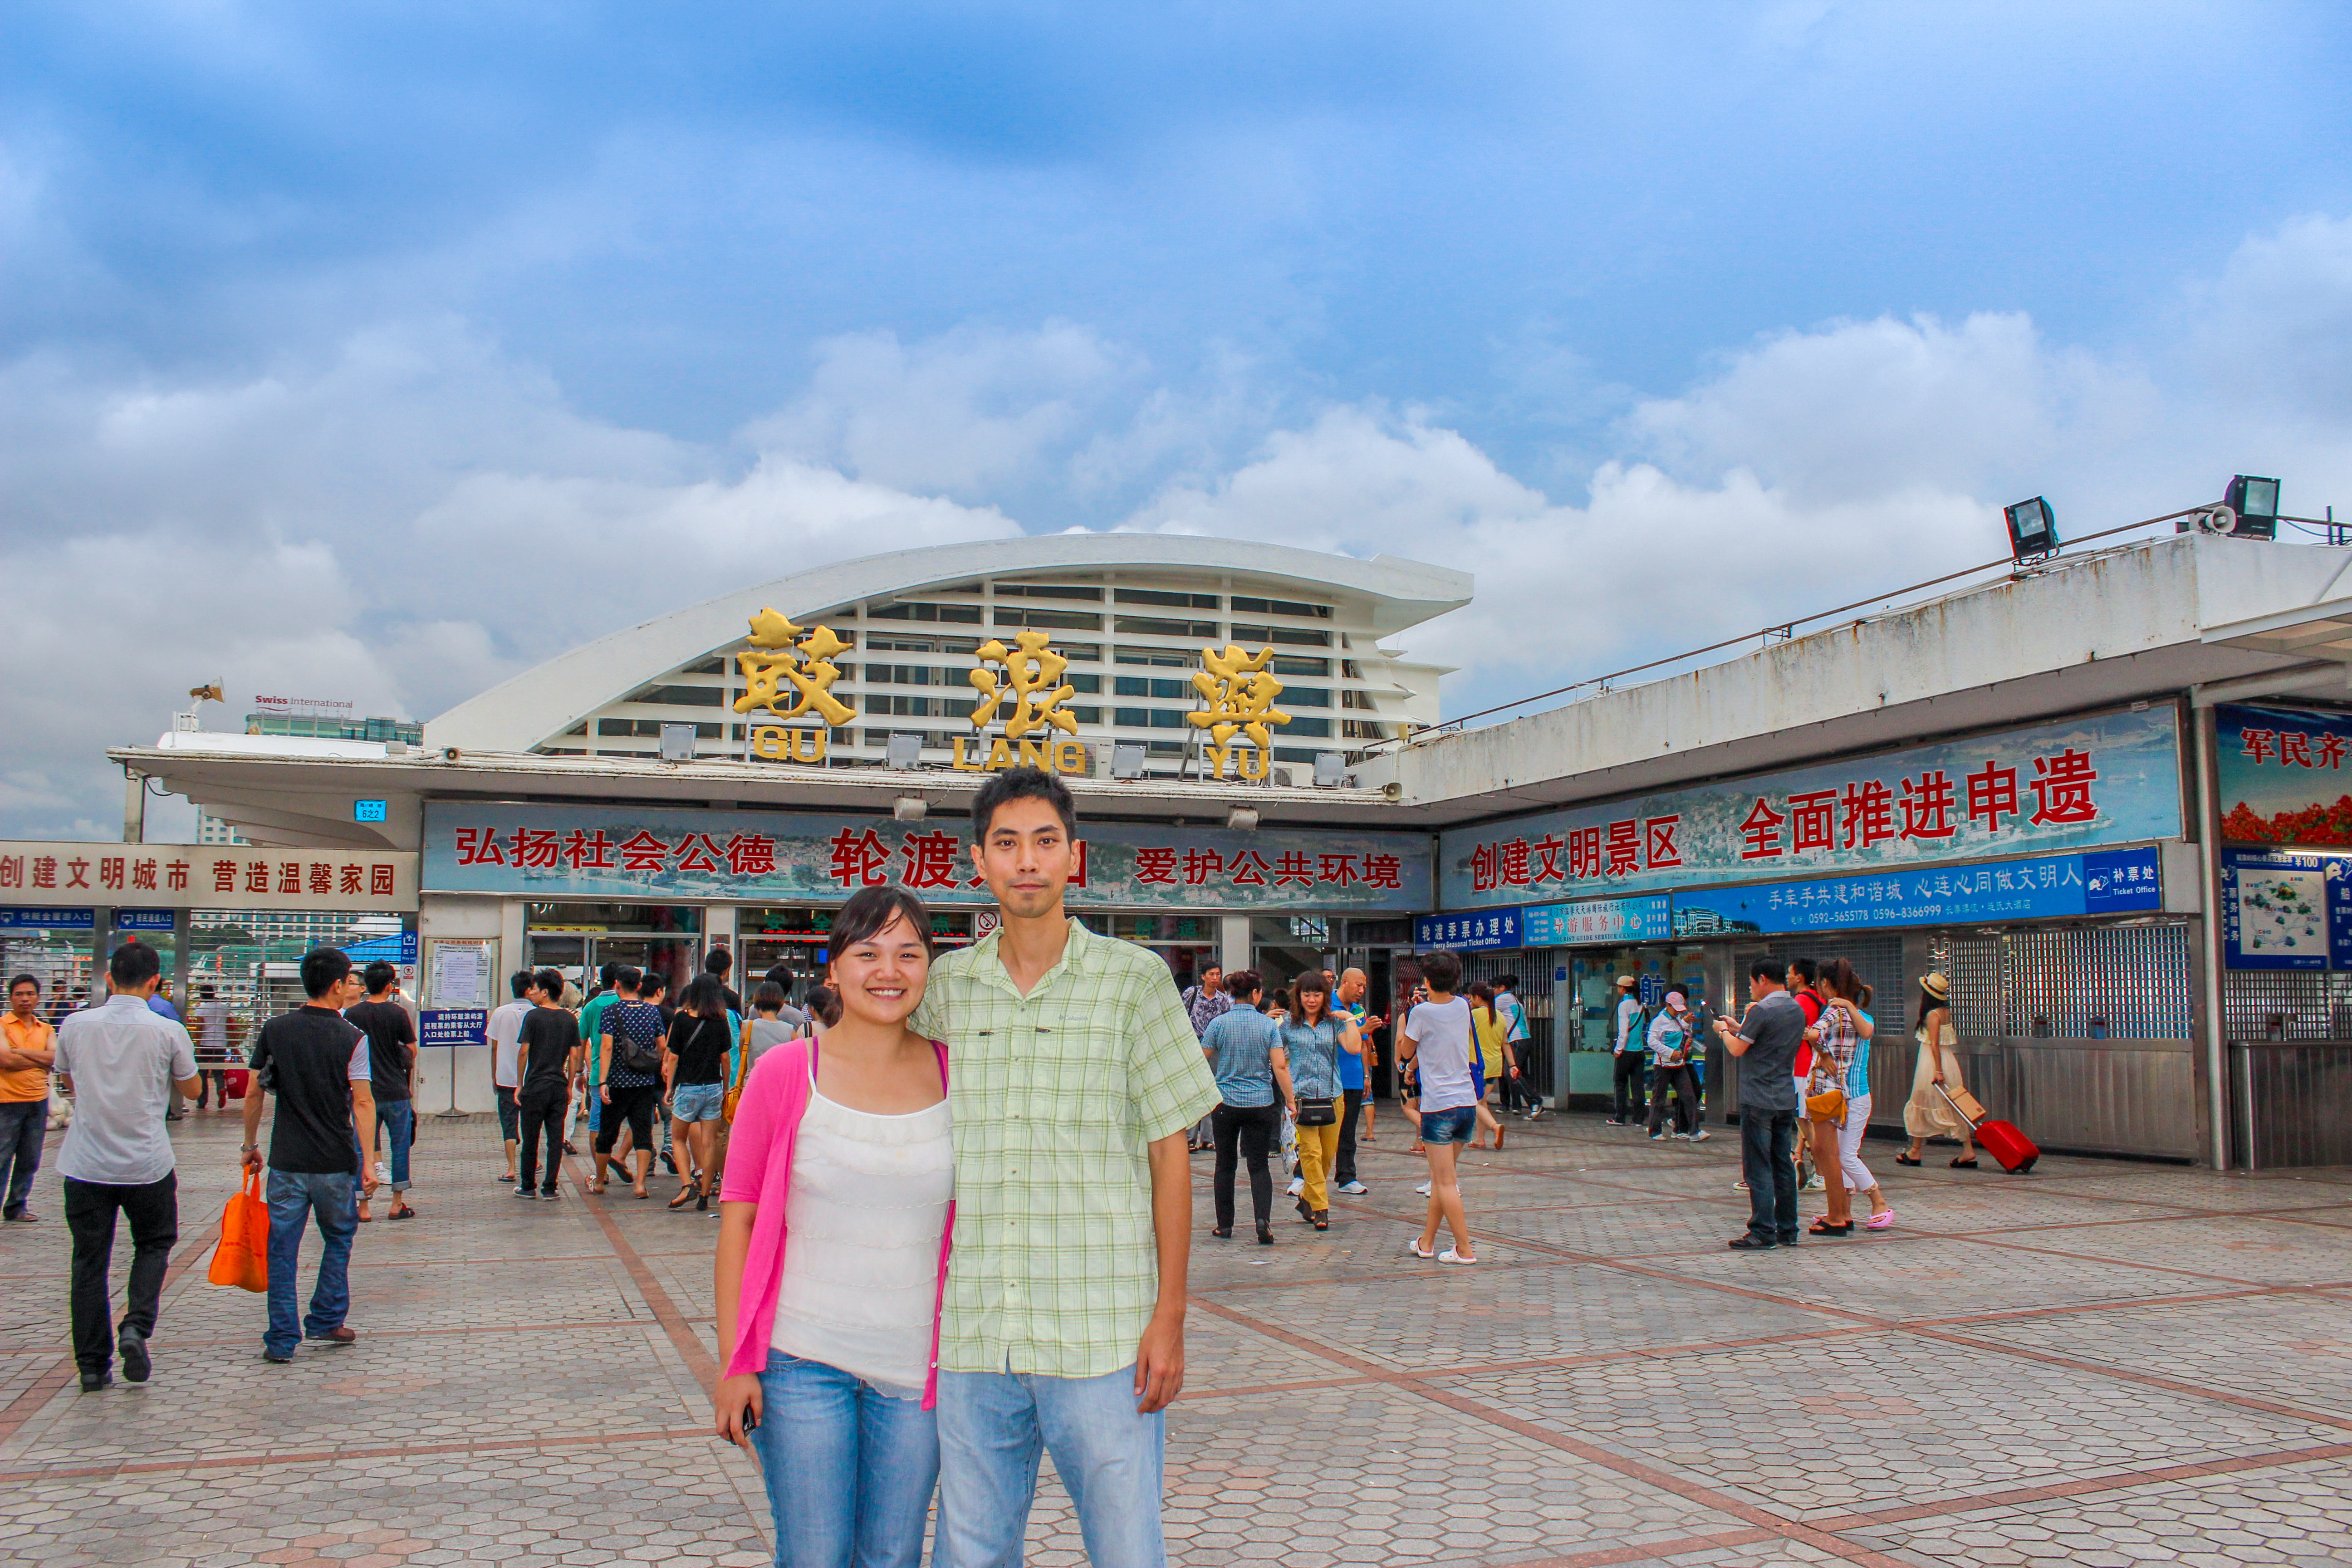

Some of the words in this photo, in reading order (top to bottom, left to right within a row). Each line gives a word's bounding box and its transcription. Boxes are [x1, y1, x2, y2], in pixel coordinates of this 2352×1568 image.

[255, 695, 288, 704] Swiss
[291, 697, 353, 708] International
[754, 725, 826, 762] GU
[953, 736, 1086, 774] LANG
[1205, 747, 1269, 780] YU
[2240, 727, 2352, 770] 军民齐
[363, 809, 379, 818] 6之2
[1470, 814, 1682, 892] 创建文明景区
[1739, 749, 2098, 860] 全面推进申遗
[456, 827, 776, 875] 弘扬社会公德
[1134, 847, 1402, 889] 爱护公共环境
[0, 855, 190, 891] 创建文明城市
[213, 860, 394, 896] 营造温馨家园
[1915, 863, 2083, 898] 心连心同做文明人
[2113, 865, 2155, 883] 补票处
[1422, 916, 1514, 941] 轮渡季票办理处
[1553, 913, 1642, 934] 导游服务中心
[1809, 910, 1869, 924] 0592-5655178
[1874, 905, 1942, 920] 0596-8366999
[1640, 974, 1665, 1007] 航
[424, 1021, 483, 1030] 返程票的乘客从大厅
